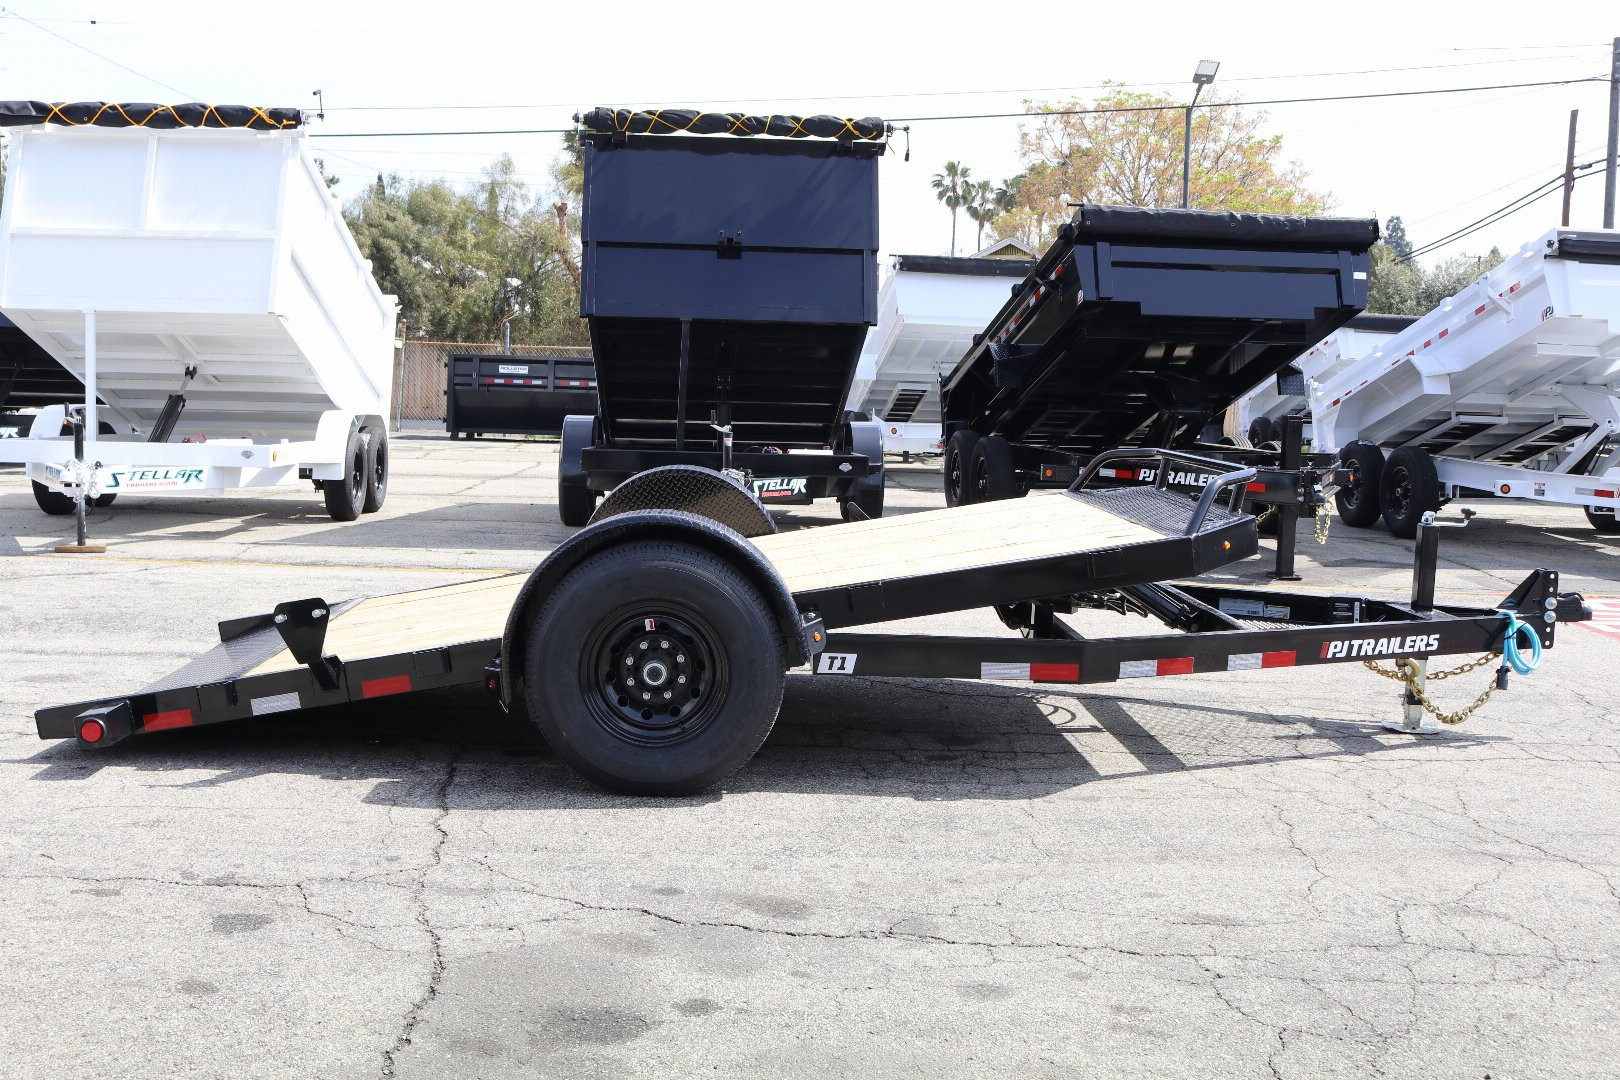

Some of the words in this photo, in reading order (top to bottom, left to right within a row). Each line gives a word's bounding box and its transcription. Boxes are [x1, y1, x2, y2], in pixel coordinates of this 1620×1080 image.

[105, 469, 204, 488] STELLAR
[752, 478, 807, 497] STELLAR
[1138, 468, 1156, 482] PJ
[1156, 469, 1236, 490] RAILE
[1326, 640, 1350, 658] PJ
[1351, 634, 1440, 657] TRAILERS
[827, 655, 847, 671] T1
